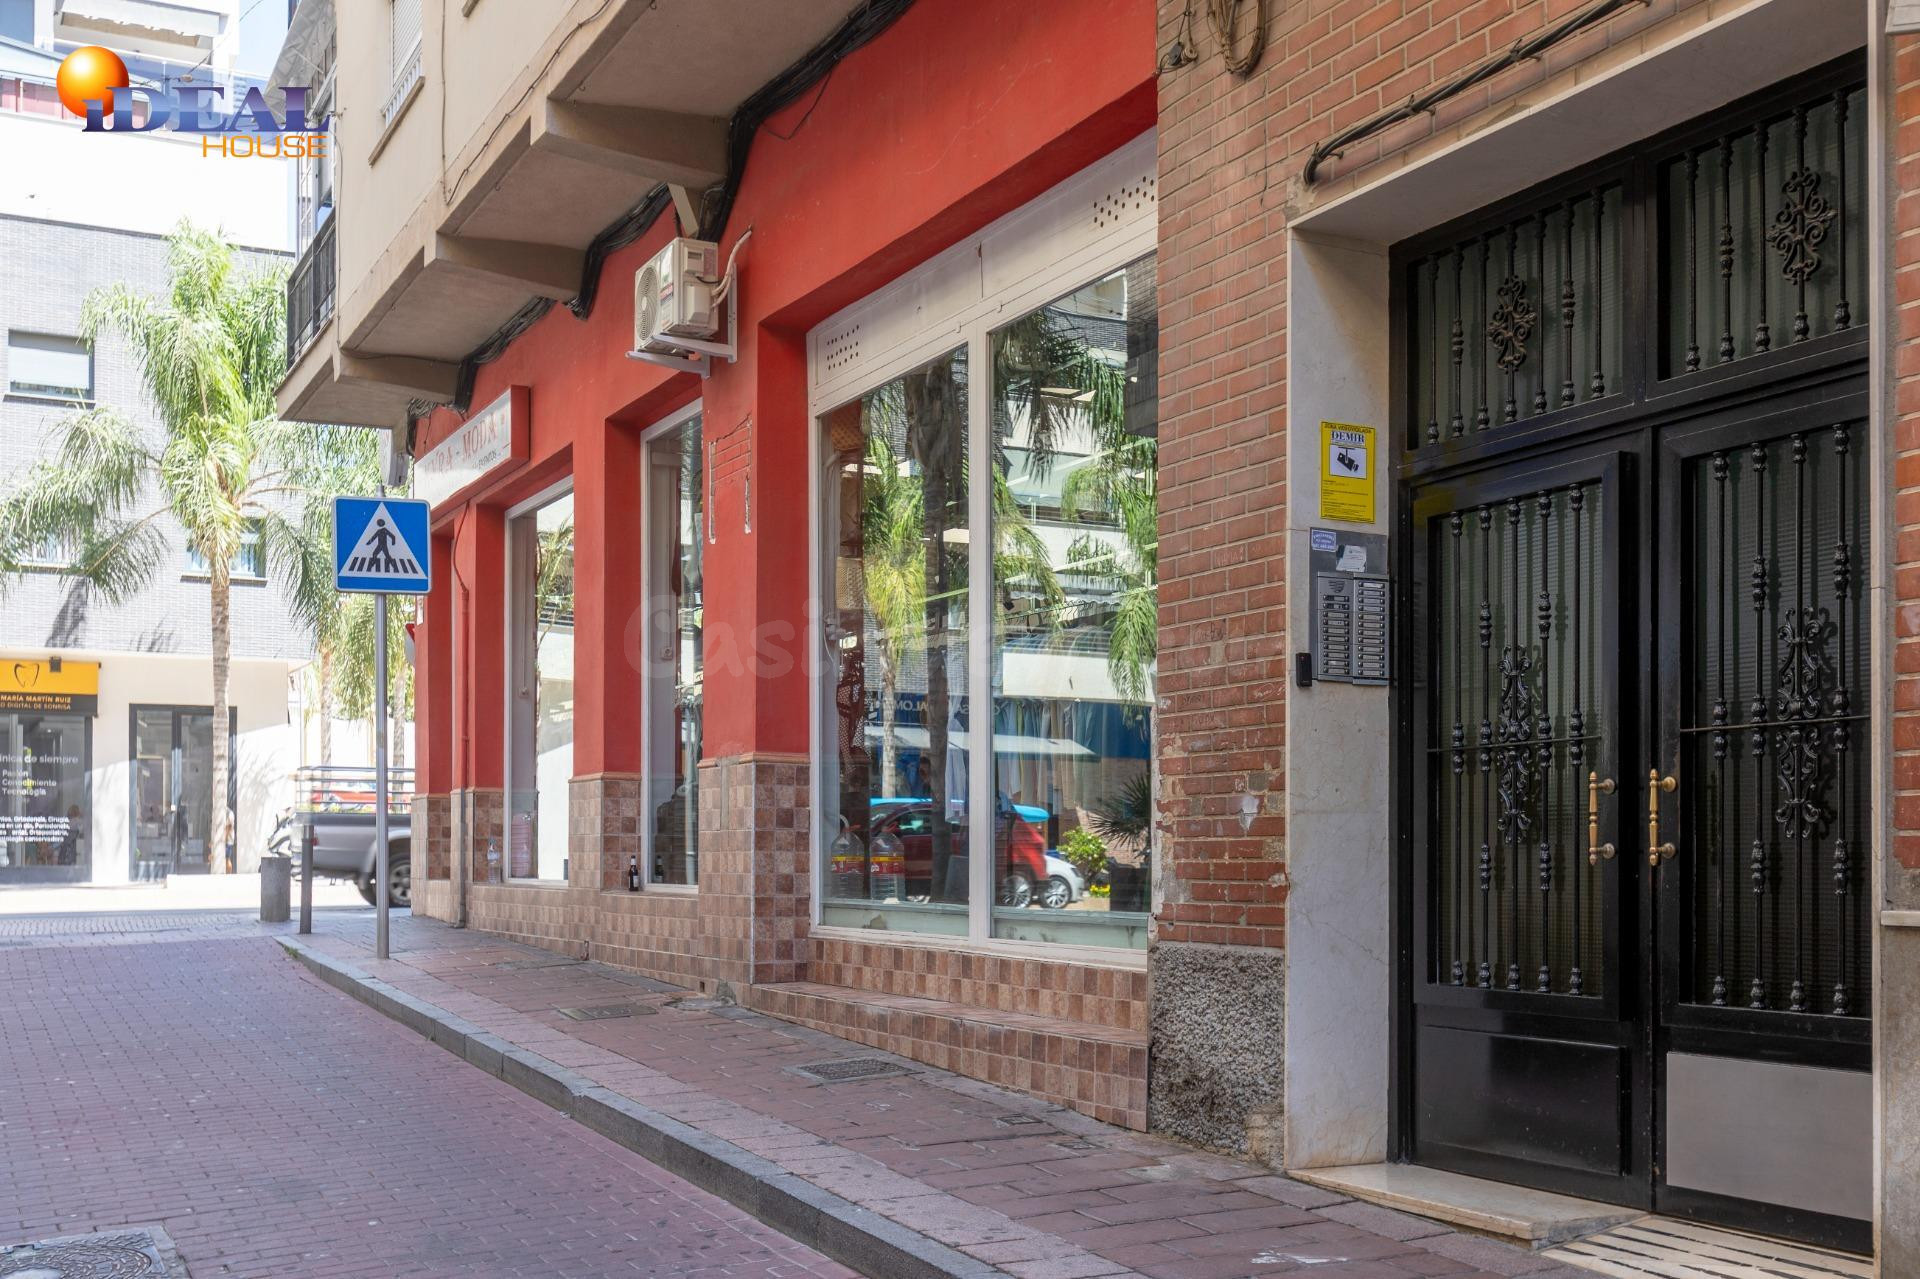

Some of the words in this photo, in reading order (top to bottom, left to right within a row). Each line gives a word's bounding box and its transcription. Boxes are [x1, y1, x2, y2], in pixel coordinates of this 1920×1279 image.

[1332, 431, 1365, 443] DEMIR
[0, 693, 24, 702] MARÍA
[26, 694, 53, 703] MARTÍN
